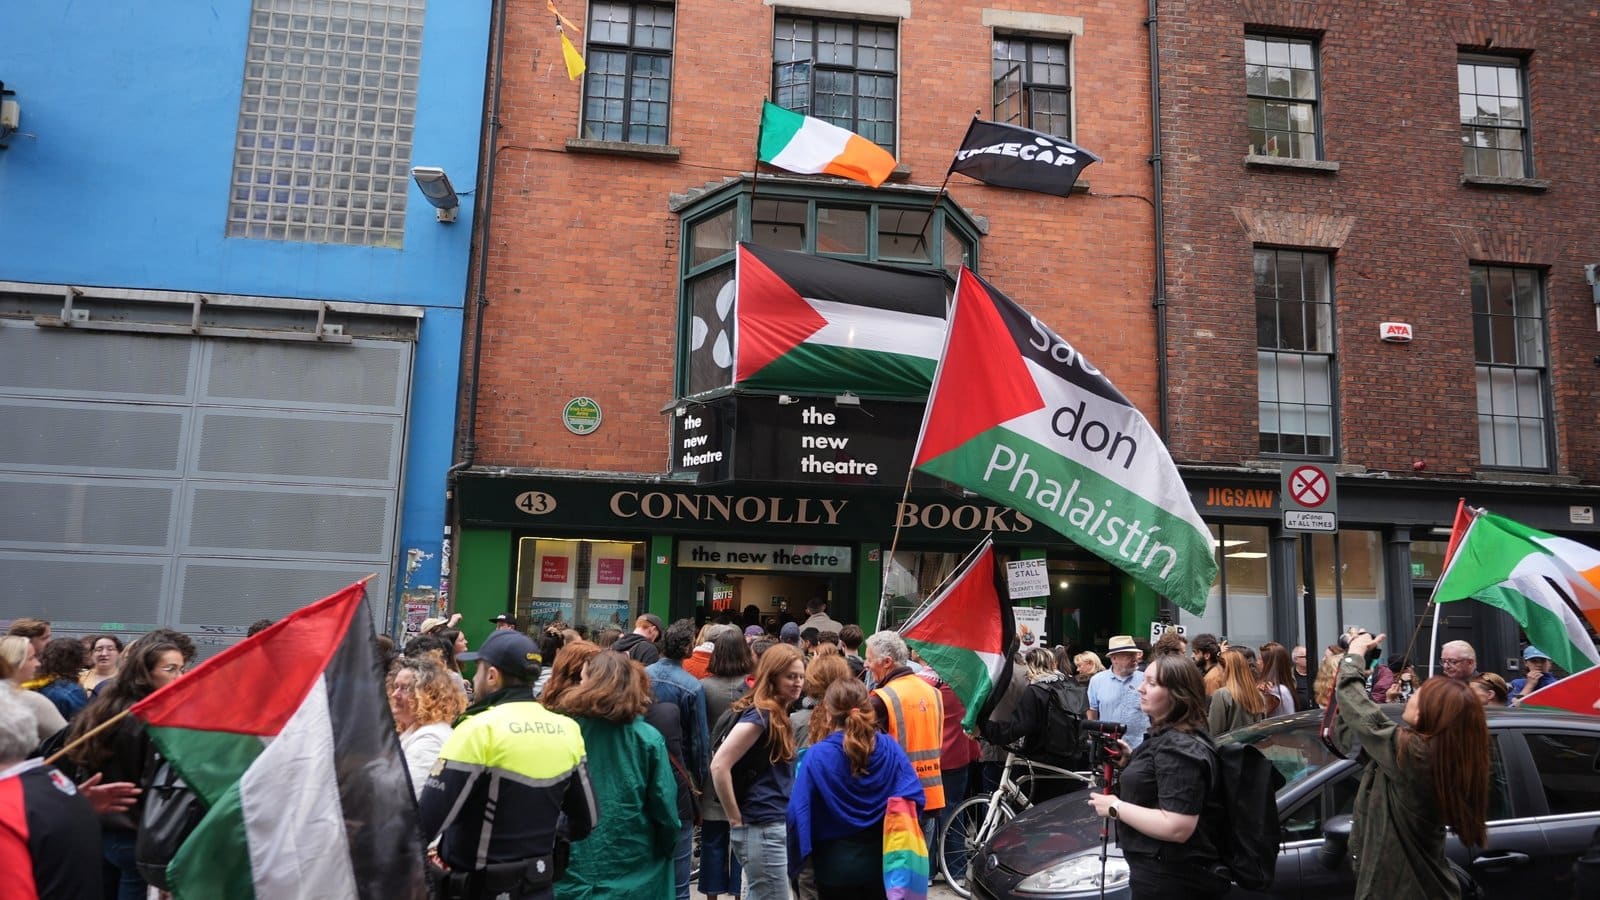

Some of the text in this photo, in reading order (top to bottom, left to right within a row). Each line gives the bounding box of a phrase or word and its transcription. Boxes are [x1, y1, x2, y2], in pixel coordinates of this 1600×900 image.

[1387, 325, 1409, 335] ATA
[684, 415, 702, 430] the
[802, 406, 836, 425] the
[683, 434, 708, 448] new
[802, 435, 848, 450] new
[1051, 401, 1137, 469] don
[682, 450, 722, 467] theatre
[801, 455, 878, 476] theatre
[520, 493, 547, 512] 43
[1207, 487, 1274, 508] JIGSAW
[609, 490, 1033, 533] CONNOLLY BOOKS
[983, 443, 1178, 580] Phalaistín
[692, 546, 839, 567] the new theatre
[1015, 570, 1040, 578] STALL
[712, 591, 733, 600] BRITS
[1153, 624, 1184, 635] STP
[509, 721, 565, 735] GARDA
